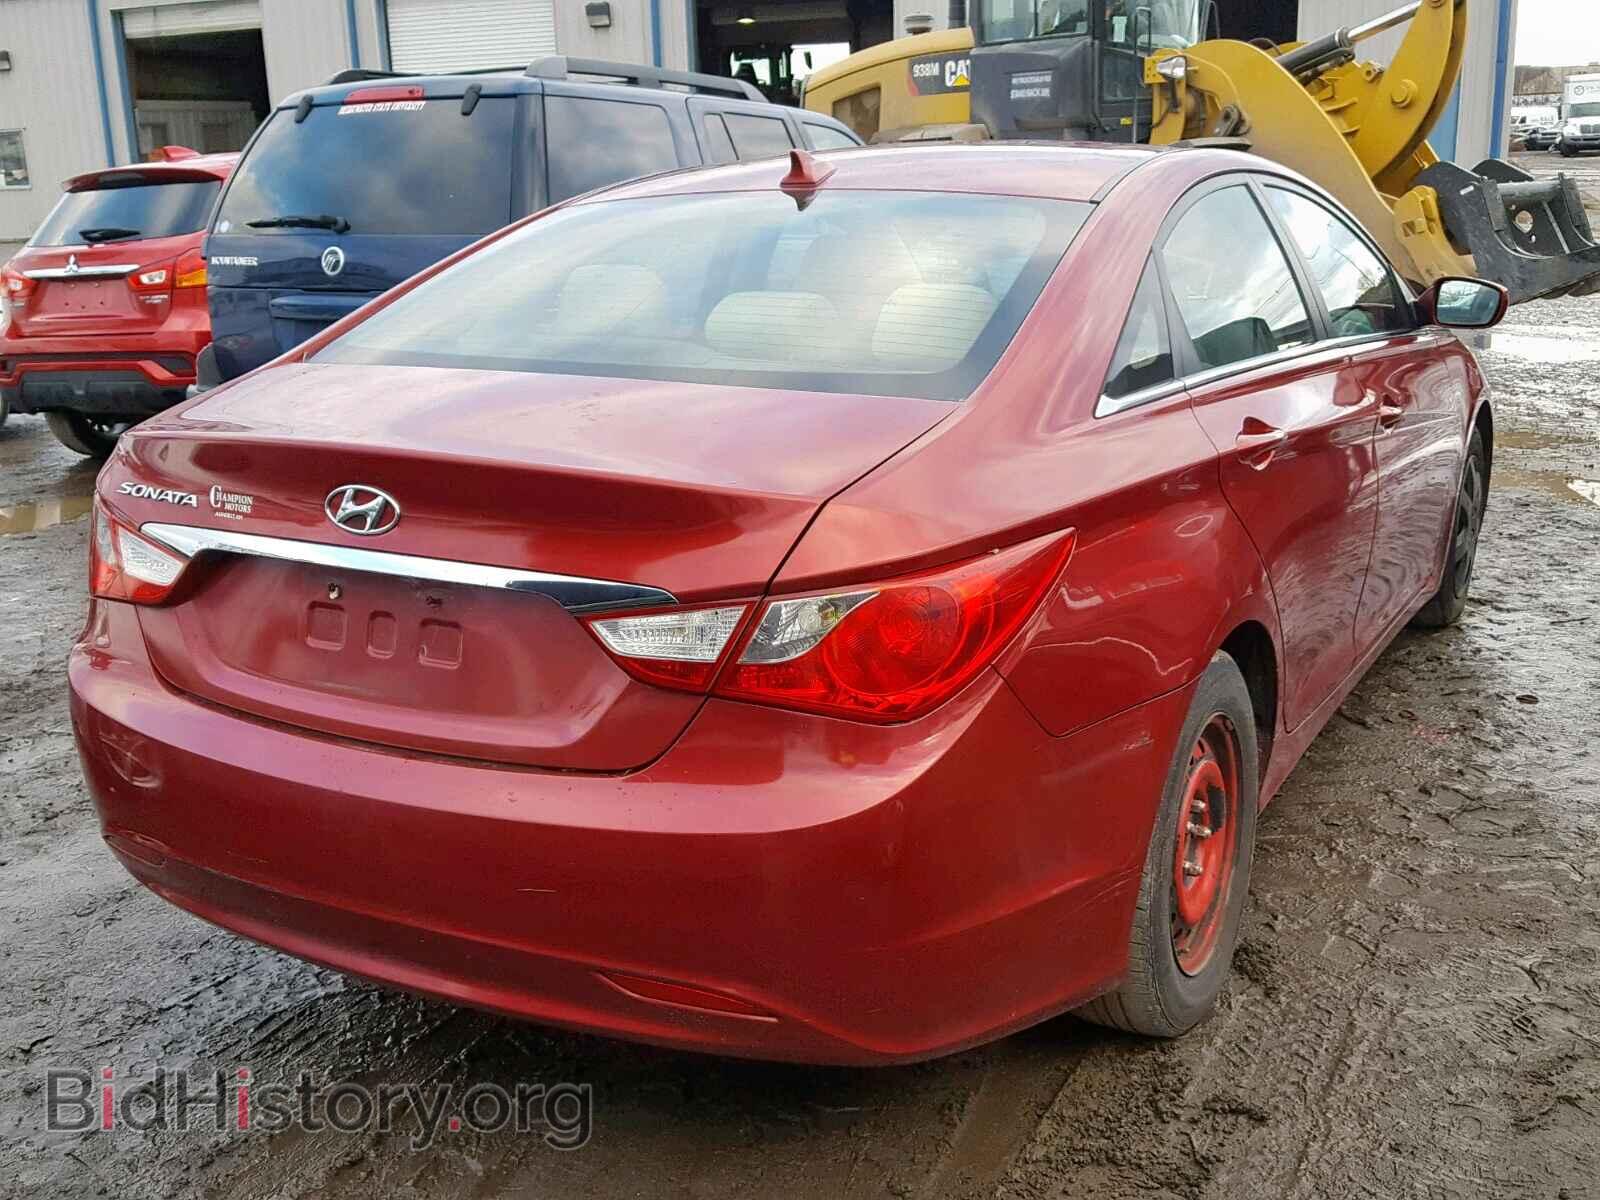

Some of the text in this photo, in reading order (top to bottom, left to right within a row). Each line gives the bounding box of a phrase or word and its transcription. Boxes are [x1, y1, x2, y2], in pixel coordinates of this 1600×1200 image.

[913, 62, 940, 77] 938M
[114, 482, 199, 507] SONATA
[209, 485, 254, 508] CHAMPION
[224, 504, 252, 514] MOTORS
